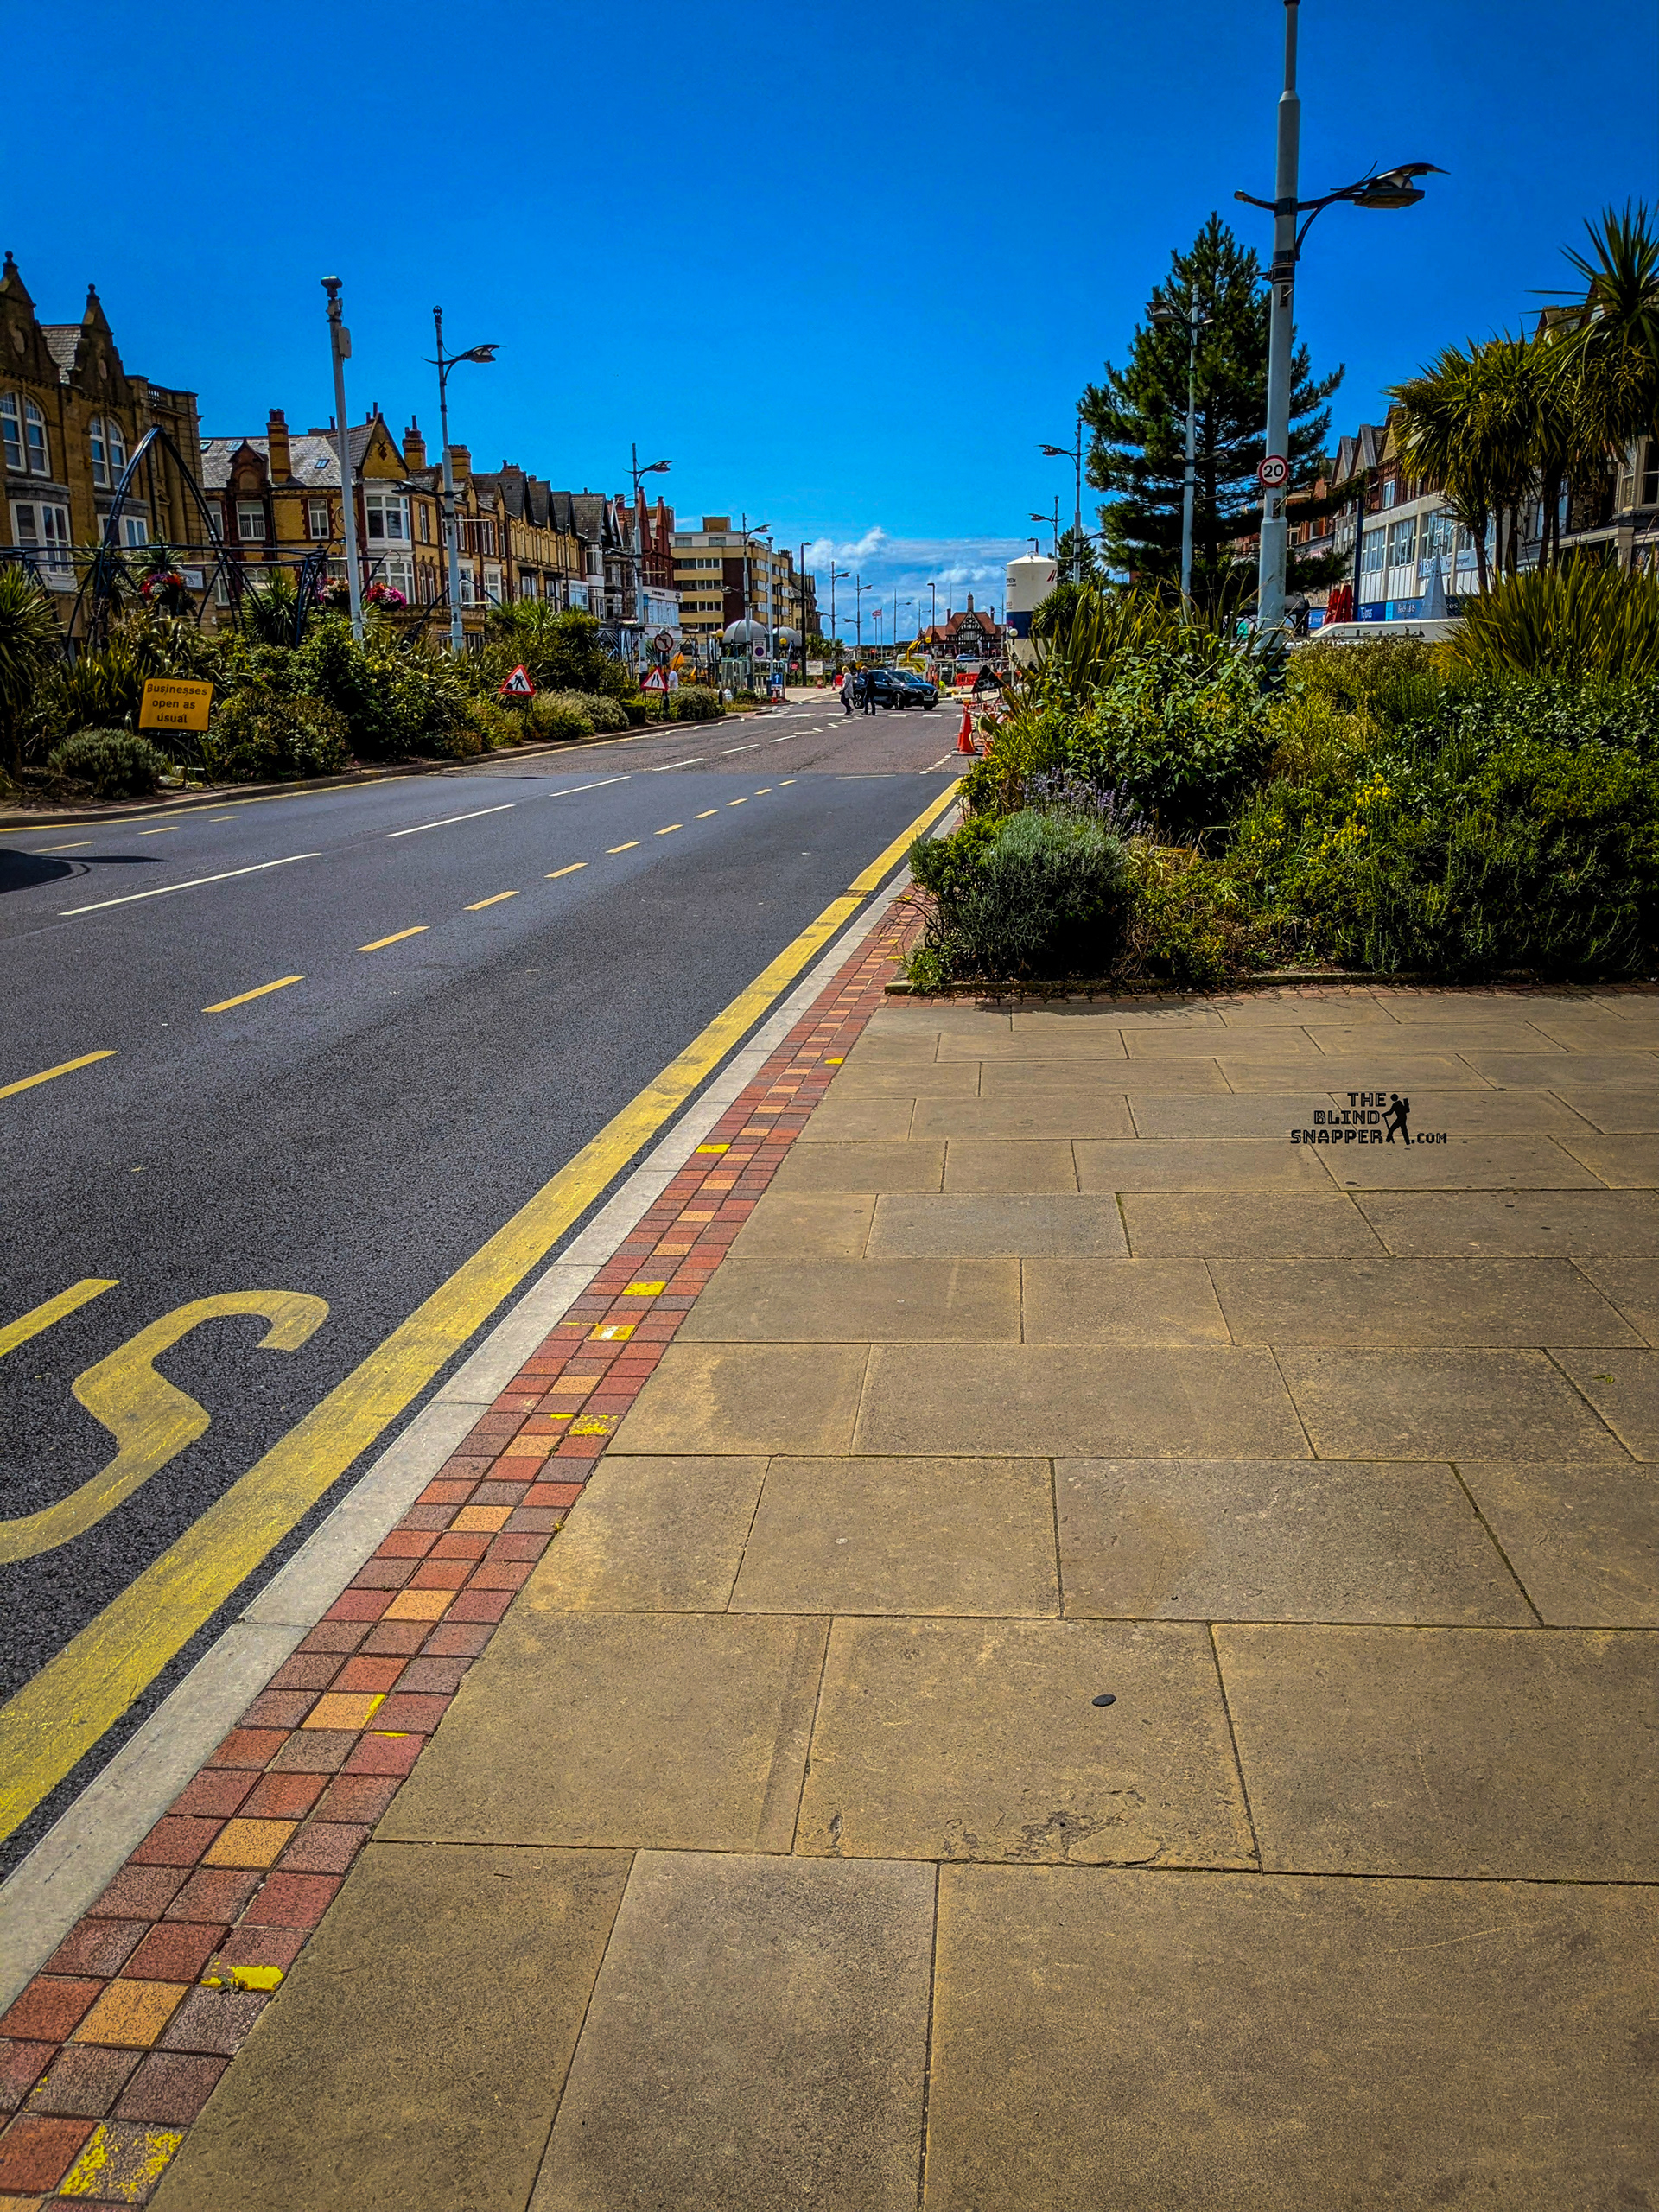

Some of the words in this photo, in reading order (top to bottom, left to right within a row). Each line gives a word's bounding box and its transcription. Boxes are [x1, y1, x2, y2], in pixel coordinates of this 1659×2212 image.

[1263, 463, 1284, 478] 20
[146, 683, 208, 696] Businesses
[152, 699, 180, 709] open
[182, 701, 196, 709] as
[156, 713, 188, 723] usual
